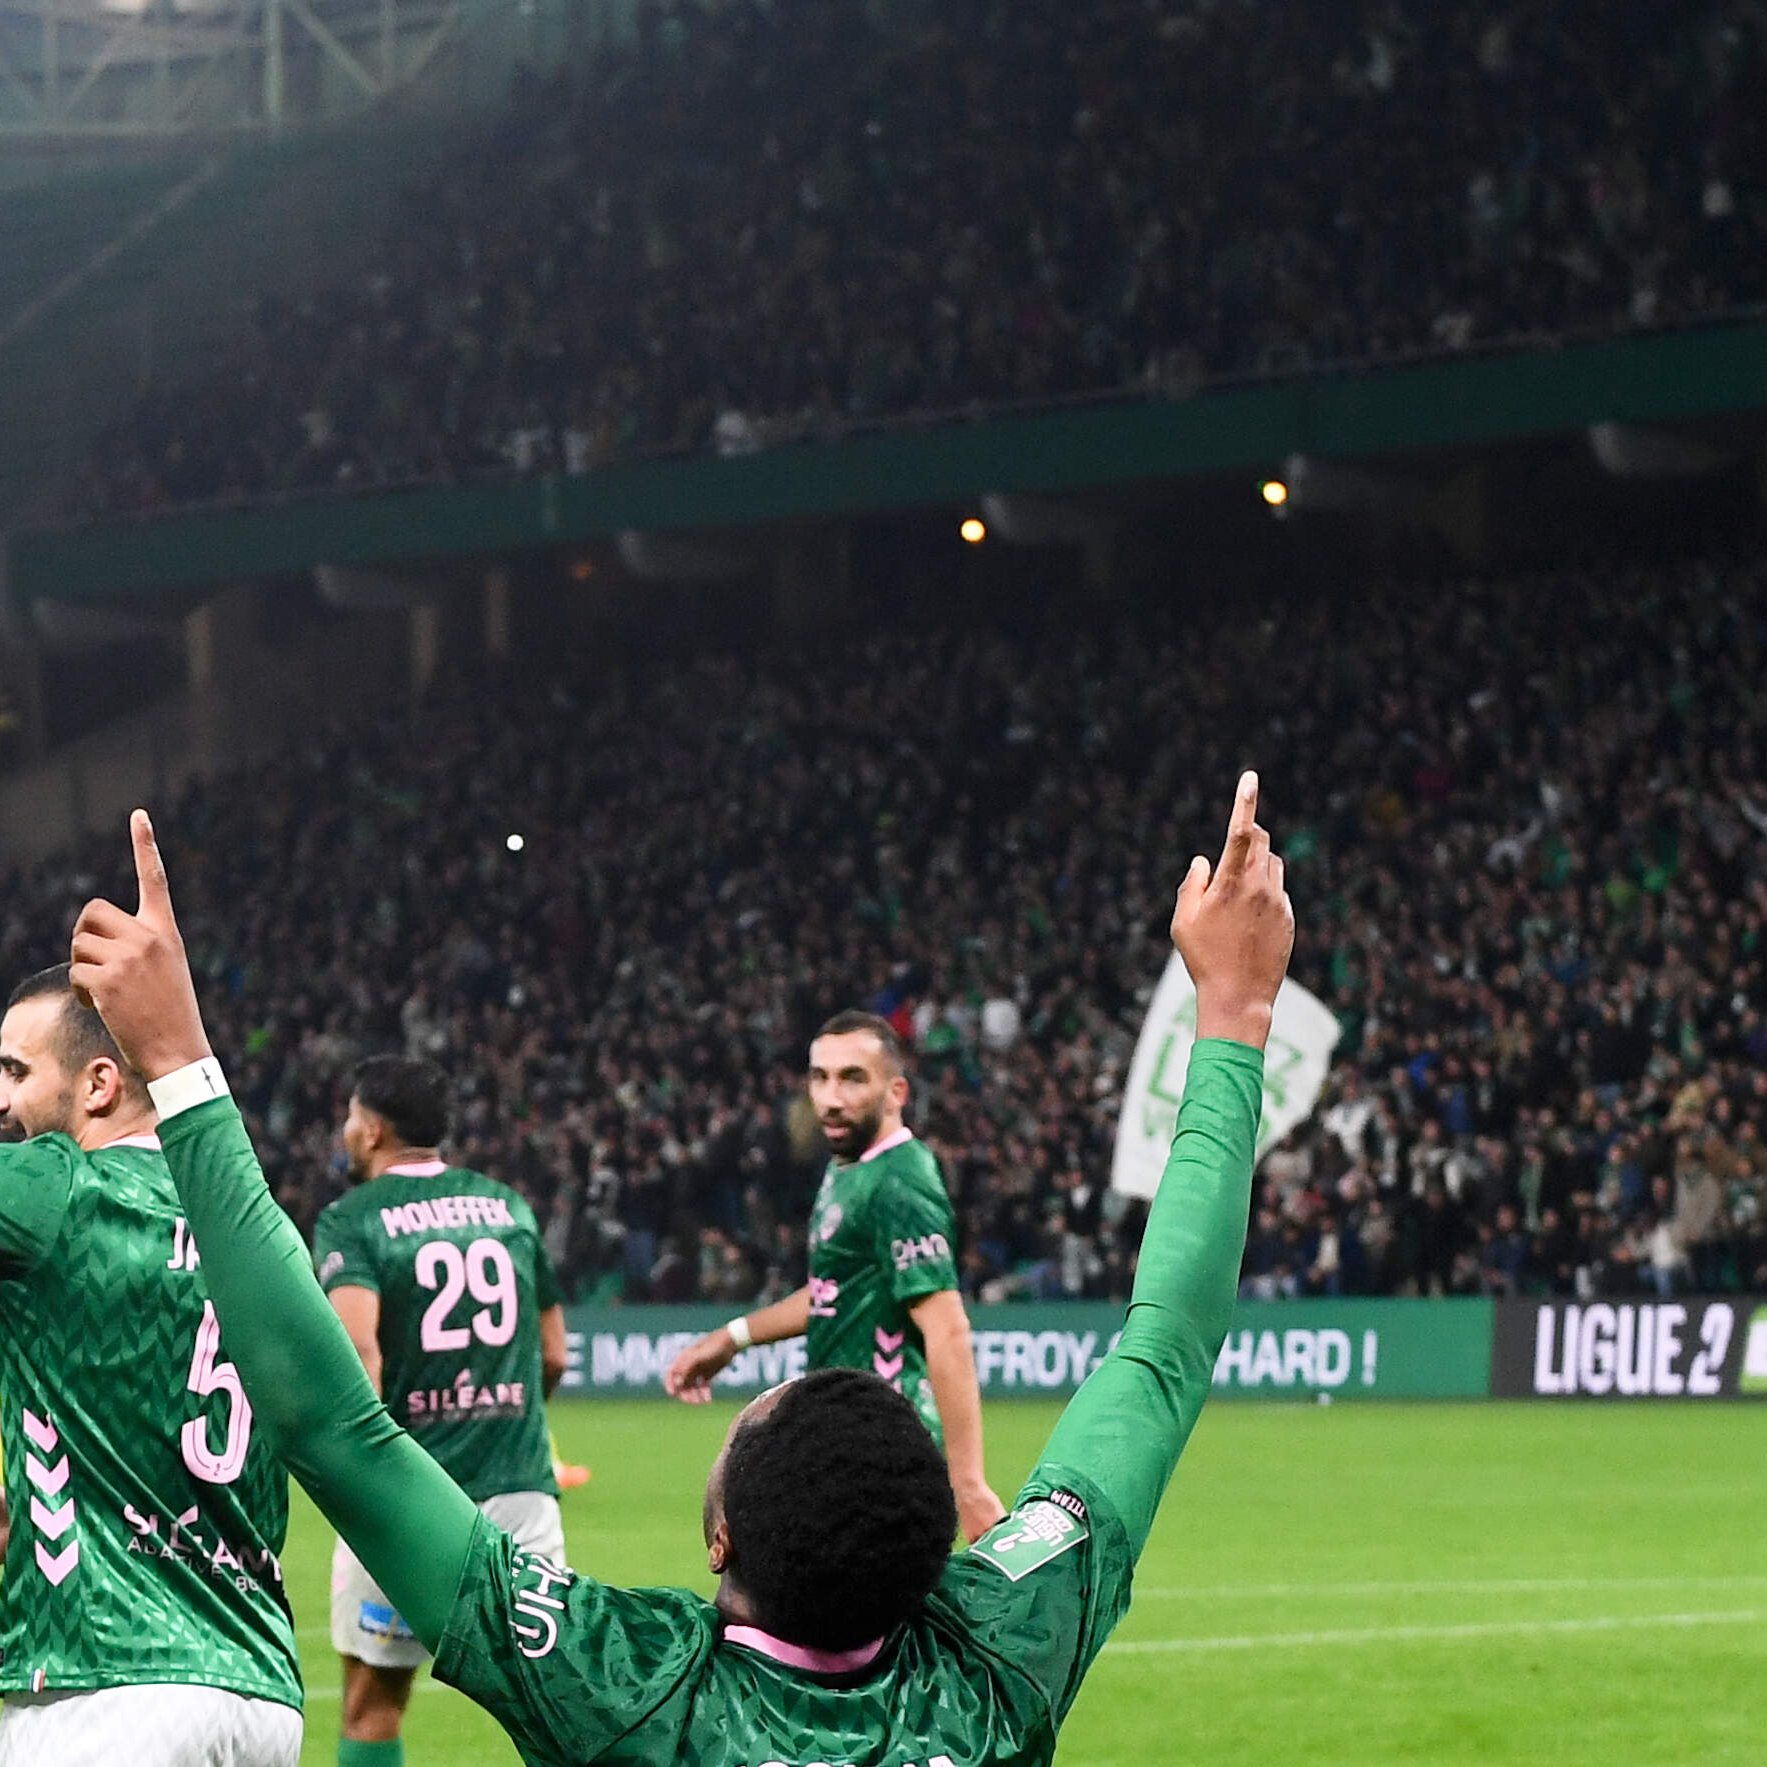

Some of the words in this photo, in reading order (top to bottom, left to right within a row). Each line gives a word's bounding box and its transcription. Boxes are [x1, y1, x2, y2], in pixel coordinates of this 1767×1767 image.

[380, 1195, 516, 1238] MOUEFFEK
[415, 1238, 518, 1352] 29
[180, 1299, 253, 1485] 5
[1534, 1303, 1688, 1395] LIGUE
[1687, 1302, 1733, 1395] 2
